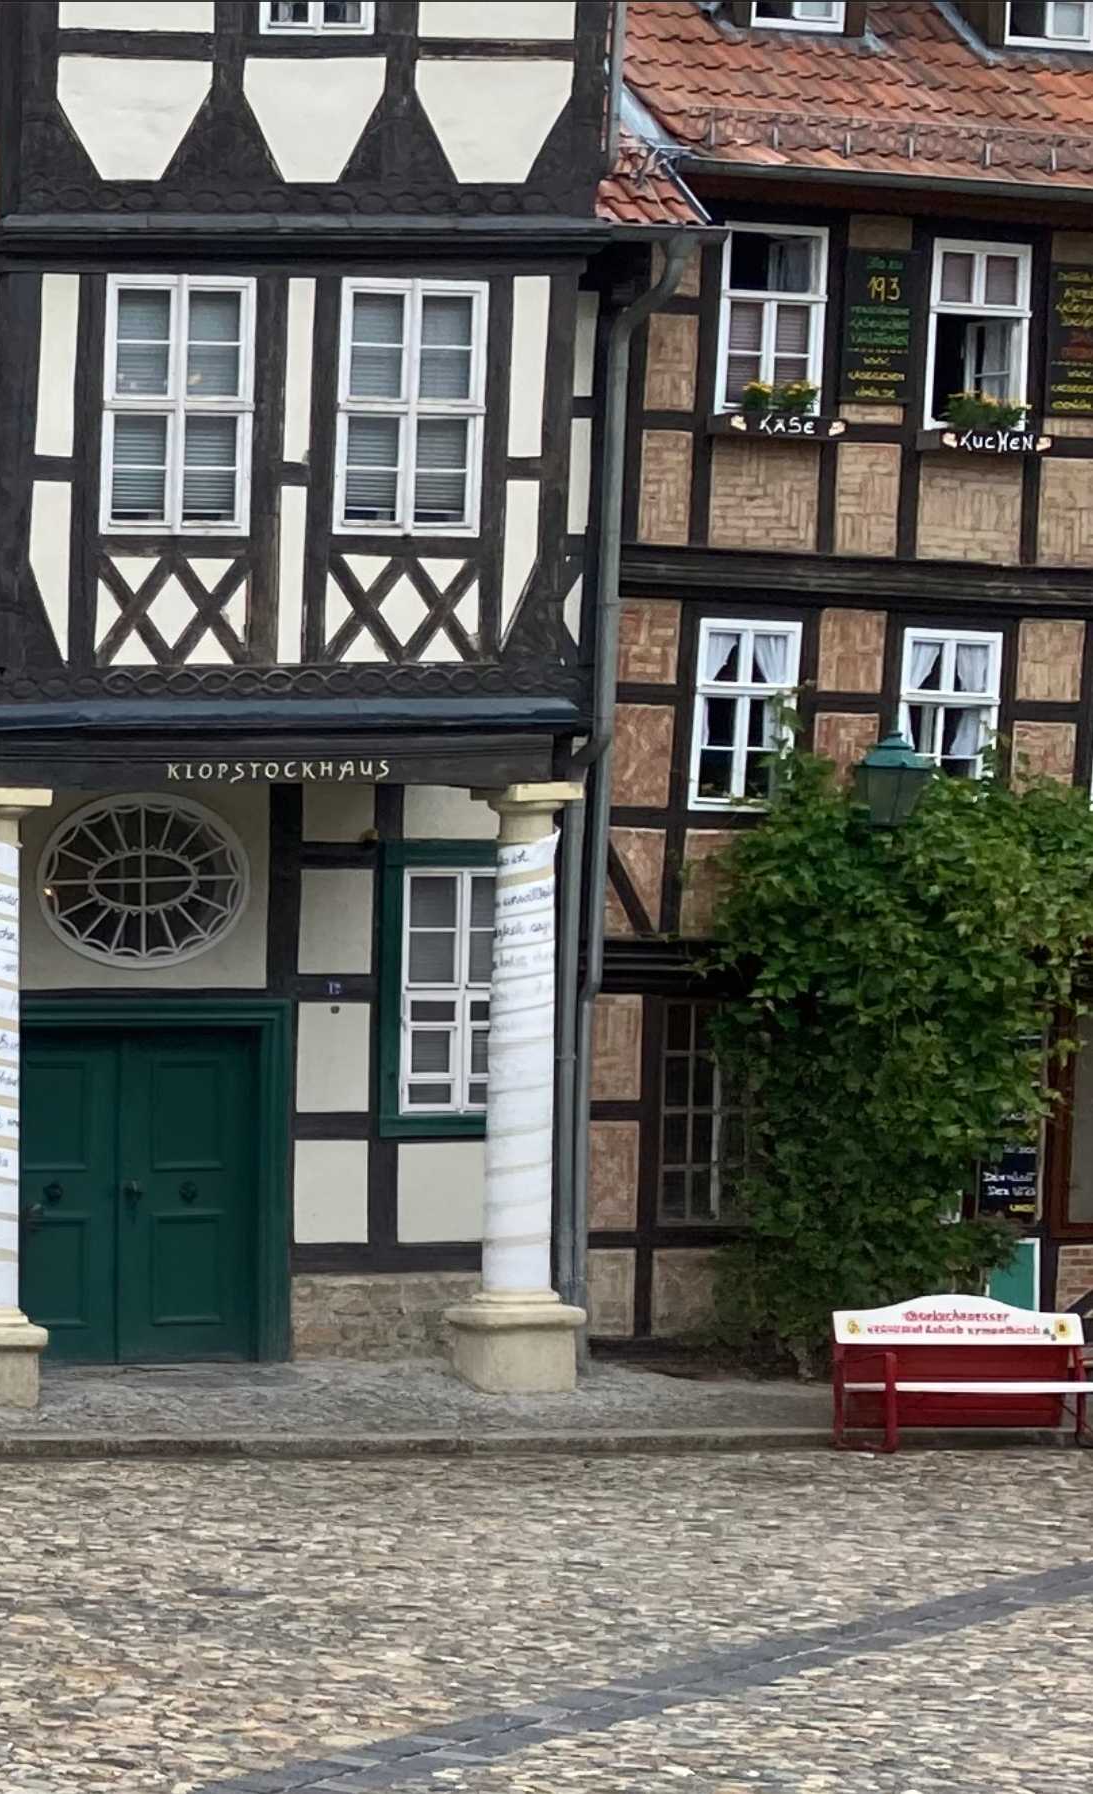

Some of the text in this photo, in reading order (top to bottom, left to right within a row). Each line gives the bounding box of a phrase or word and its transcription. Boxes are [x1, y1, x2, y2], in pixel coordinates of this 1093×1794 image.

[867, 276, 901, 302] 193
[759, 412, 816, 435] KÄSE
[960, 429, 1034, 453] KUCHEN
[167, 759, 390, 784] KLOPSTOCKHAUS
